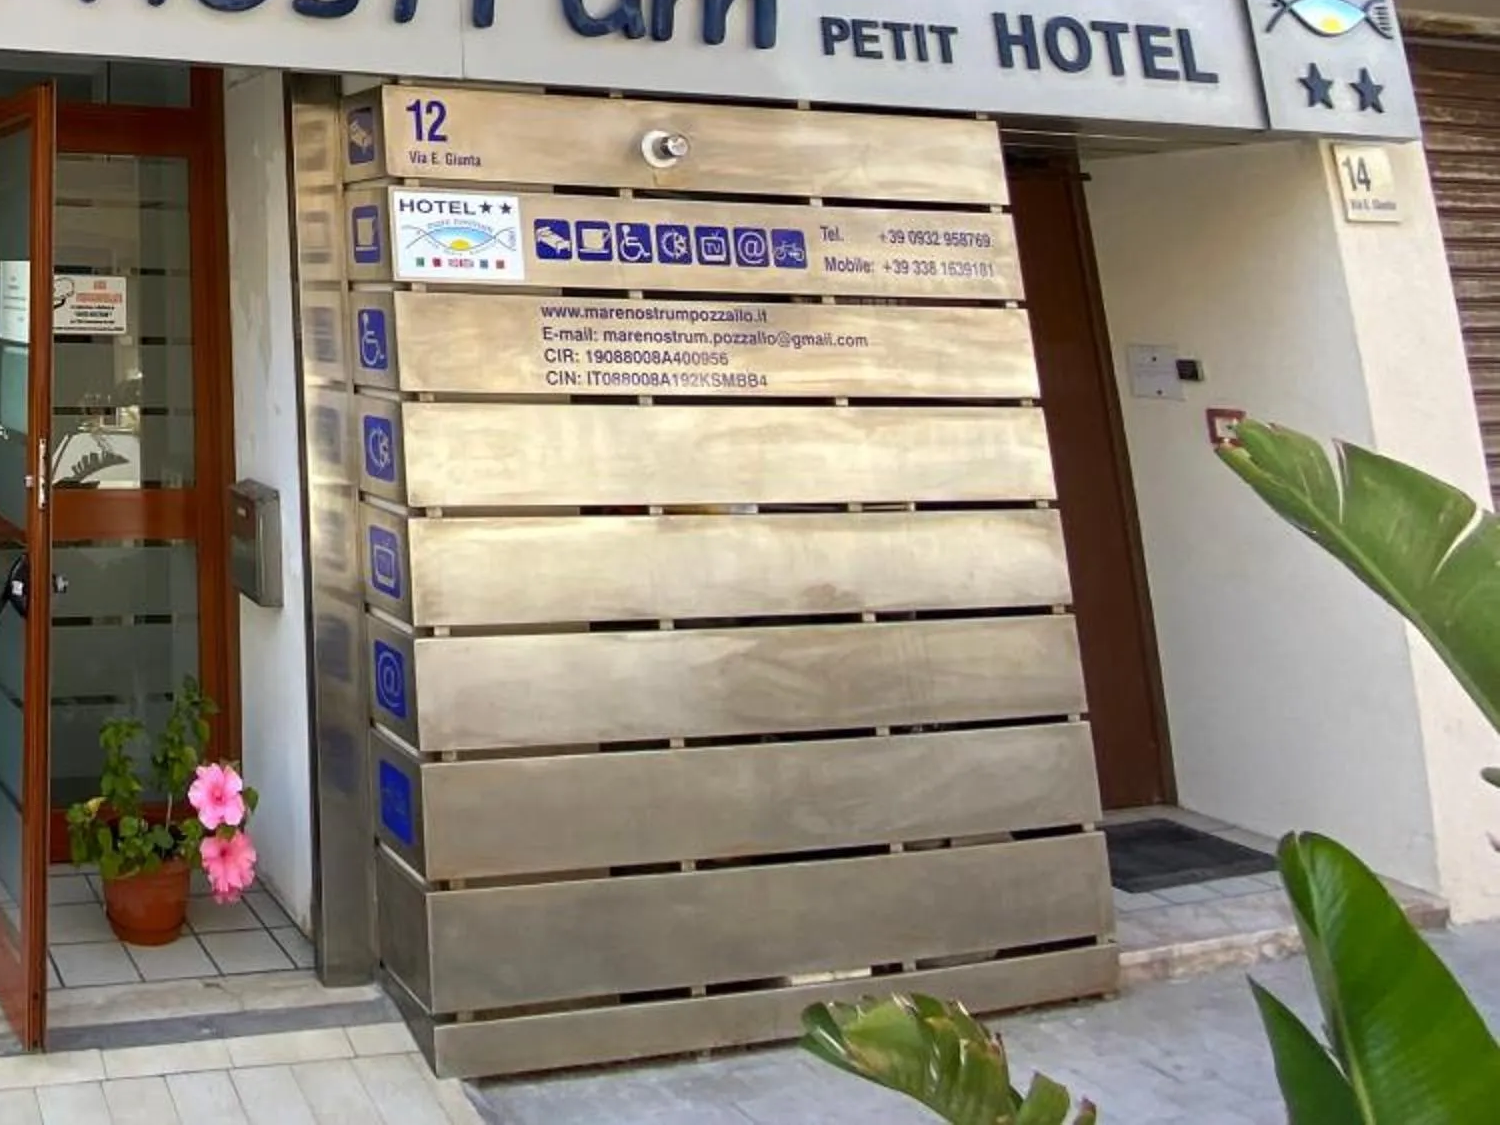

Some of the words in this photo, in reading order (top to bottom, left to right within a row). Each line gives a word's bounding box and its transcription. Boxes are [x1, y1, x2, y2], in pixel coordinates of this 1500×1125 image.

[820, 15, 958, 65] PETIT
[991, 11, 1220, 85] HOTEL
[405, 98, 448, 143] 12
[409, 151, 428, 164] Via
[431, 152, 441, 165] E.
[445, 153, 481, 167] Giunta
[1341, 155, 1371, 192] 14
[399, 198, 476, 216] HOTEL
[820, 226, 844, 242] Tel.
[879, 228, 905, 244] +39
[907, 230, 941, 246] 0932
[824, 257, 874, 273] Mobile:
[883, 259, 909, 274] +39
[541, 307, 768, 324] www.marenostrumpozzallo.it
[543, 327, 598, 342] E-mail:
[544, 348, 580, 365] CIR:
[546, 370, 581, 386] CIN:
